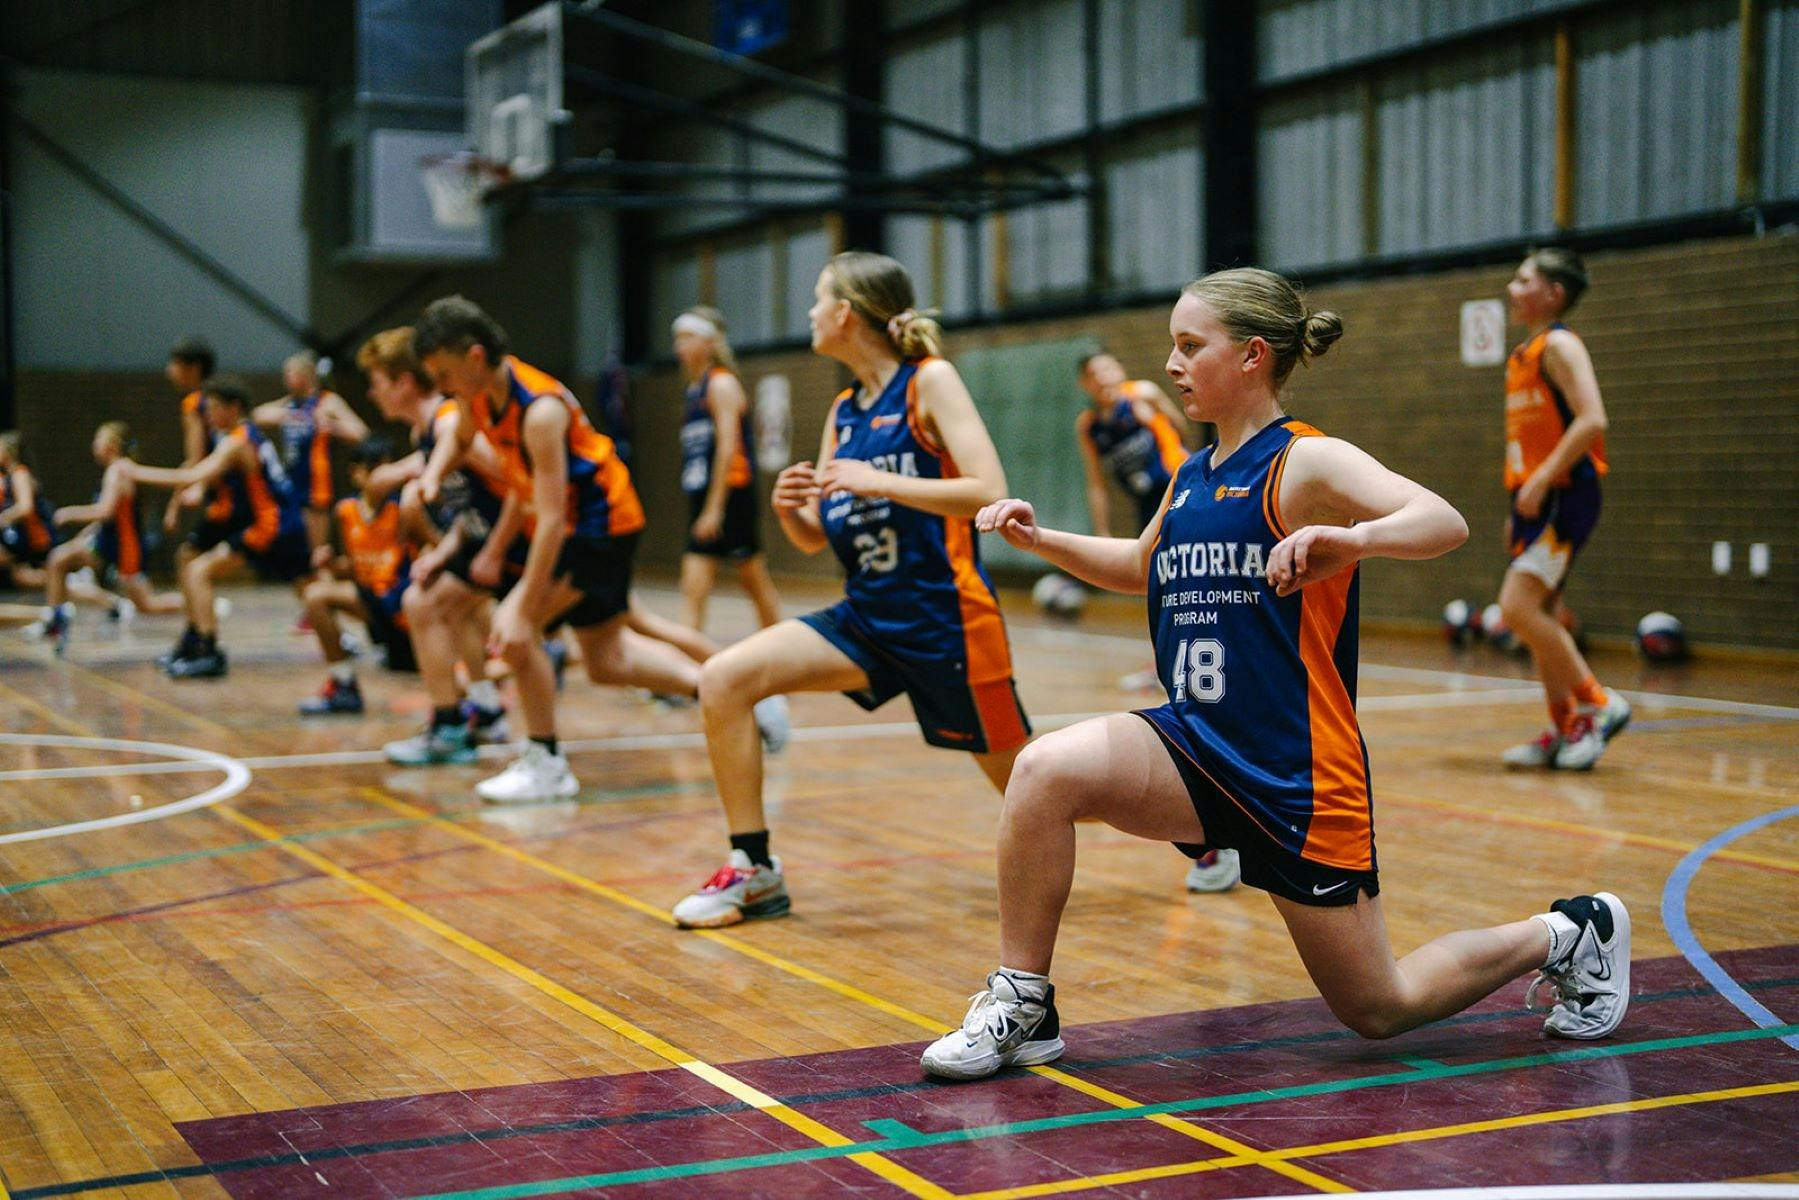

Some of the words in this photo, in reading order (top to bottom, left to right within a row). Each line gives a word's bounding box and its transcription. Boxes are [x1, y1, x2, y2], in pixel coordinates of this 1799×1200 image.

[1157, 542, 1267, 586] VCTORIA
[1180, 590, 1261, 606] DEVELOPMENT
[1174, 611, 1218, 626] PROGRAM
[1172, 638, 1226, 704] 48
